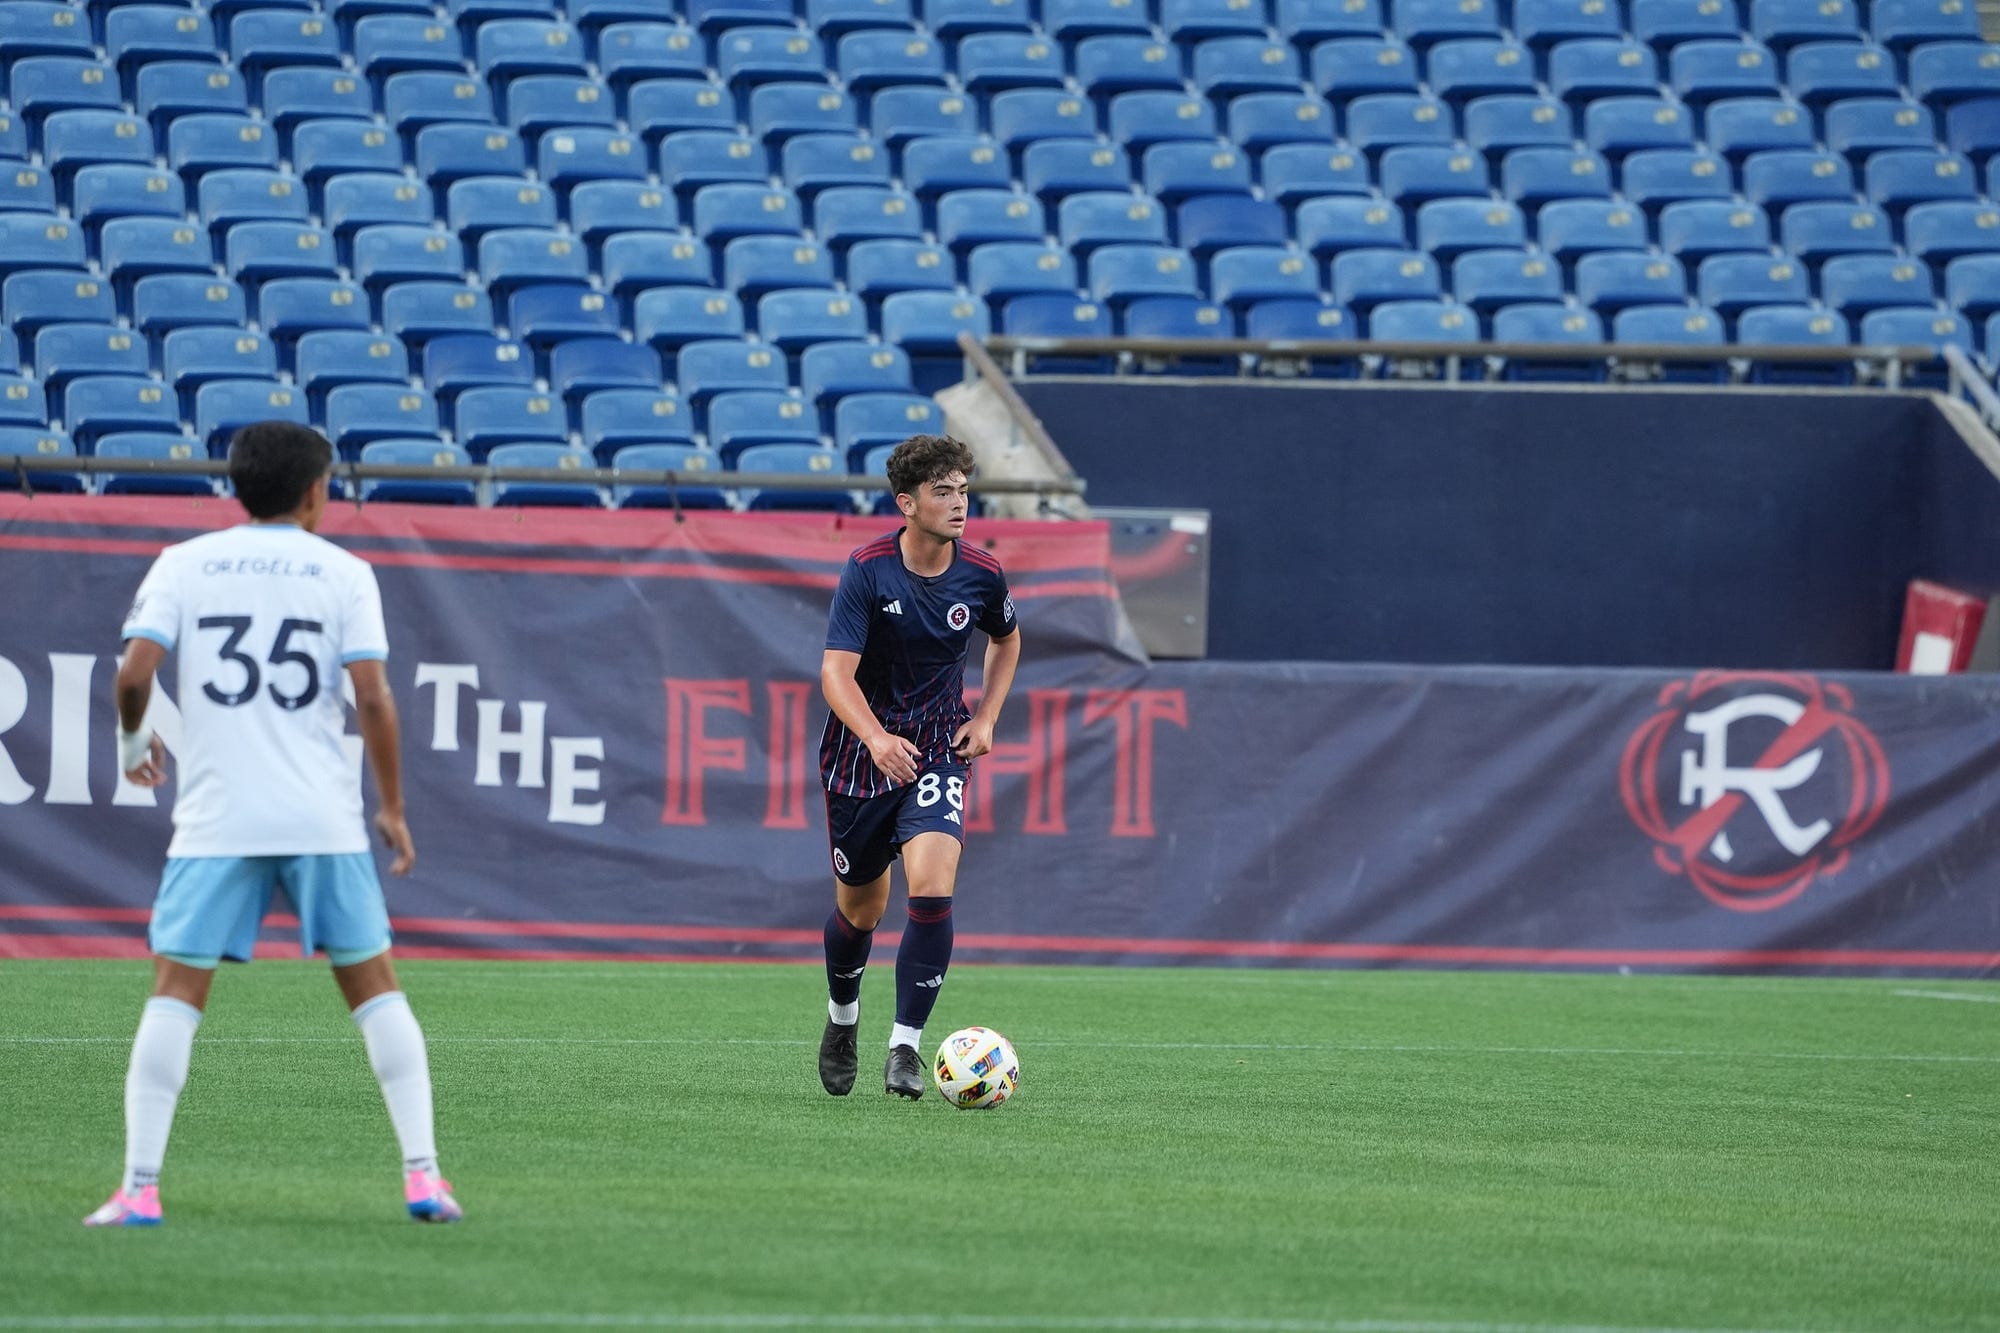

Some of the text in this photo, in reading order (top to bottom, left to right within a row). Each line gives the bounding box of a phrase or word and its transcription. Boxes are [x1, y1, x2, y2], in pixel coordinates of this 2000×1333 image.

[198, 615, 323, 712] 35
[414, 662, 606, 826] THE
[661, 678, 1188, 838] FIHT
[917, 773, 964, 811] 88
